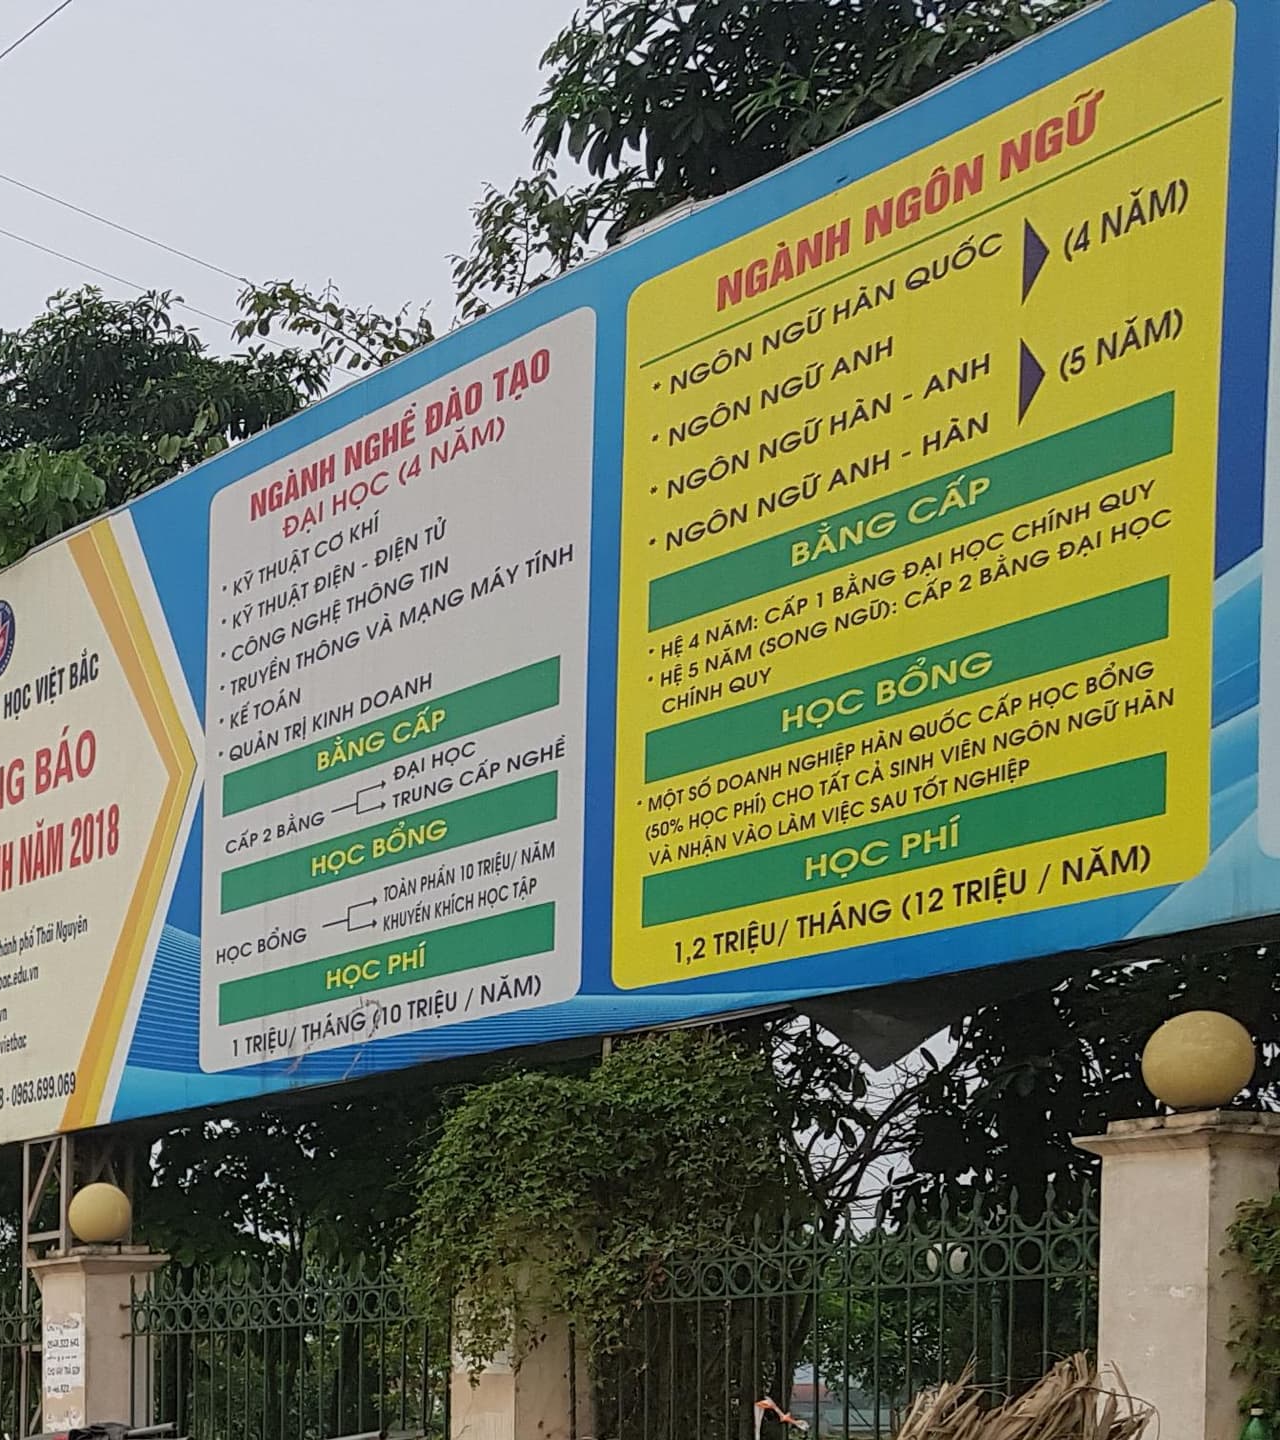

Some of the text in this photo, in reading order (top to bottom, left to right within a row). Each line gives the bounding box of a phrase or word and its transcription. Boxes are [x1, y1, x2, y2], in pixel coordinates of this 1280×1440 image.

[717, 88, 1105, 312] NGÀNH NGÔN NGỮ
[1064, 179, 1188, 261] (4 NĂM)
[671, 234, 1002, 394] NGÔN NGỮ HÀN QUỐC
[1060, 309, 1182, 381] (5 NĂM)
[251, 349, 549, 521] NGÀNH NGHỀ ĐÀO TẠO
[283, 417, 505, 538] ĐẠI HỌC (4 NĂM)
[234, 510, 379, 596] KỸ THUẬT CƠ KHÍ
[791, 475, 989, 566] BẰNG CẤP
[662, 480, 1155, 659] HỆ 4 NĂM: CẤP 1 BẰNG ĐẠI HỌC CHÍNH QUY
[231, 544, 572, 695] TRUYỀN THÔNG VÀ MẠNG MÁY TÍNH
[232, 557, 448, 664] CÔNG NGHỆ THÔNG TIN
[4, 684, 30, 719] HỌC
[36, 667, 64, 703] VIỆT
[70, 648, 98, 689] BẮC
[230, 673, 431, 761] QUẢN TRỊ KINH DOANH
[231, 688, 300, 729] KẾ TOÁN
[662, 668, 771, 713] CHÍNH QUY
[783, 653, 992, 732] HỌC BỔNG
[36, 726, 96, 795] BÁO
[318, 706, 445, 770] BẰNG CẤP
[393, 735, 565, 808] TRUNG CẤP NGHỀ
[394, 742, 475, 780] ĐẠI HỌC
[20, 822, 63, 885] NĂM
[70, 805, 119, 868] 2018
[226, 812, 324, 853] CẤP 2 BẰNG
[312, 820, 447, 876] HỌC BỔNG
[649, 758, 1029, 865] VÀ NHẬN VÀO LÀM VIỆC SAU TỐT NGHIỆP
[806, 815, 960, 881] HỌC PHÍ
[384, 878, 416, 901] TOÀN
[462, 864, 473, 880] 10
[478, 852, 517, 876] TRIỆU/
[522, 841, 554, 864] NĂM
[384, 876, 536, 931] KHUYẾN KHÍCH HỌC TẬP
[675, 845, 1150, 964] 1,2 TRIỆU/ THÁNG (12 TRIỆU NĂM)
[217, 927, 306, 964] HỌC BỔNG
[327, 941, 426, 989] HỌC PHÍ
[245, 1027, 296, 1054] TRIỆU/
[302, 1006, 366, 1042] THÁNG
[408, 990, 456, 1019] TRIỆU
[481, 975, 541, 1005] NĂM)
[12, 1072, 76, 1106] 0963.699.069
